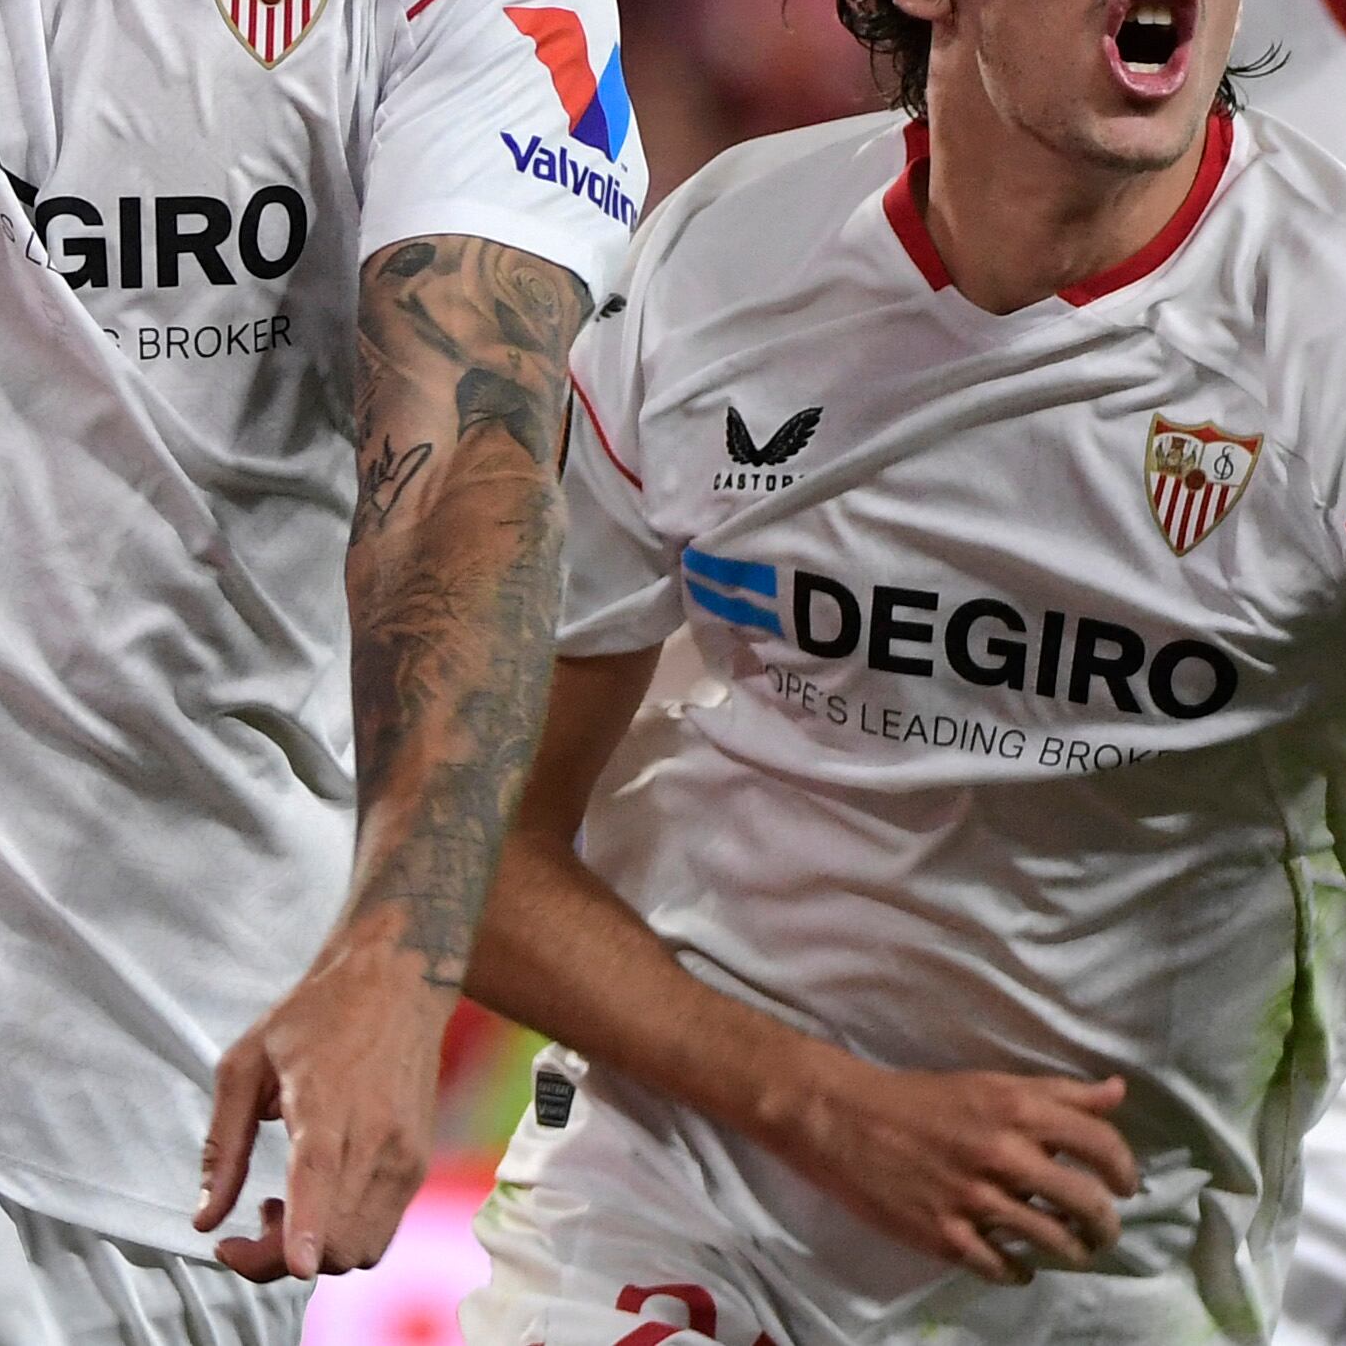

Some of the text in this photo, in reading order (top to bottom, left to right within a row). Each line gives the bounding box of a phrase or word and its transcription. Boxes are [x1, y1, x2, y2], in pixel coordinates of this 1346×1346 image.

[138, 314, 292, 360] BROKER
[792, 568, 1239, 720] DEGIRO
[860, 702, 1027, 760] LEADING
